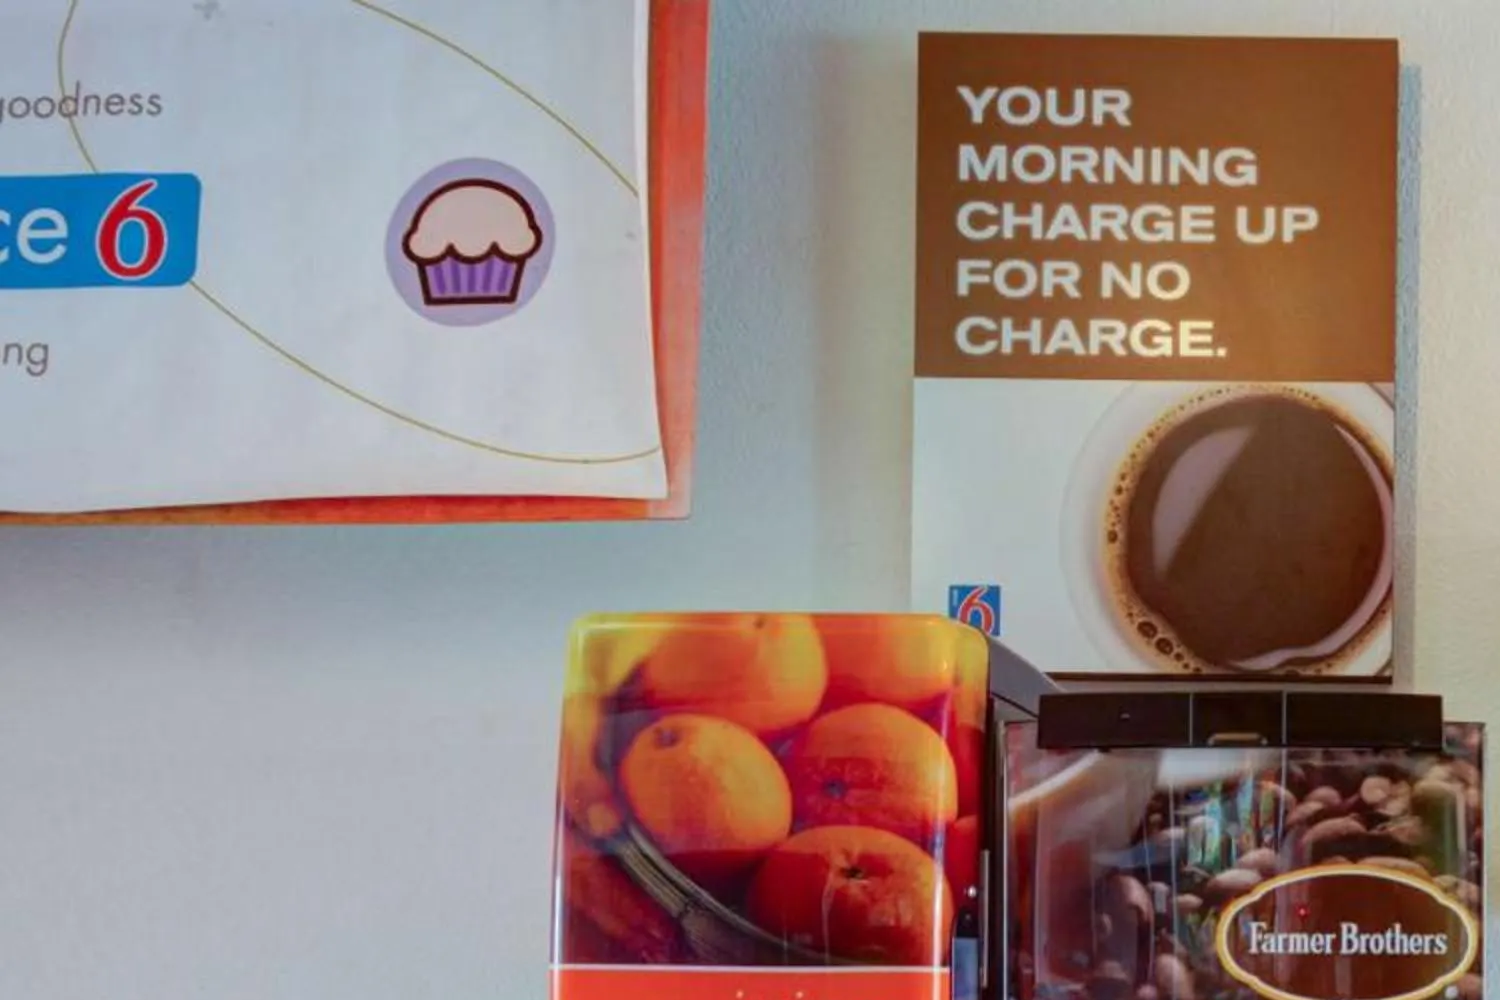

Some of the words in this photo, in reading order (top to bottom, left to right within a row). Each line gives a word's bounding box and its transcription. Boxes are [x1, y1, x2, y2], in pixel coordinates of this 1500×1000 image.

[956, 85, 1132, 127] YOUR
[957, 144, 1258, 186] MORNING
[95, 179, 167, 281] 6
[955, 201, 1216, 244] CHARGE
[1235, 206, 1319, 245] UP
[957, 260, 1082, 299] FOR
[1101, 263, 1191, 300] NO
[954, 316, 1228, 358] CHARGE.
[1248, 921, 1336, 956] Farmer
[1340, 921, 1448, 957] Brothers
